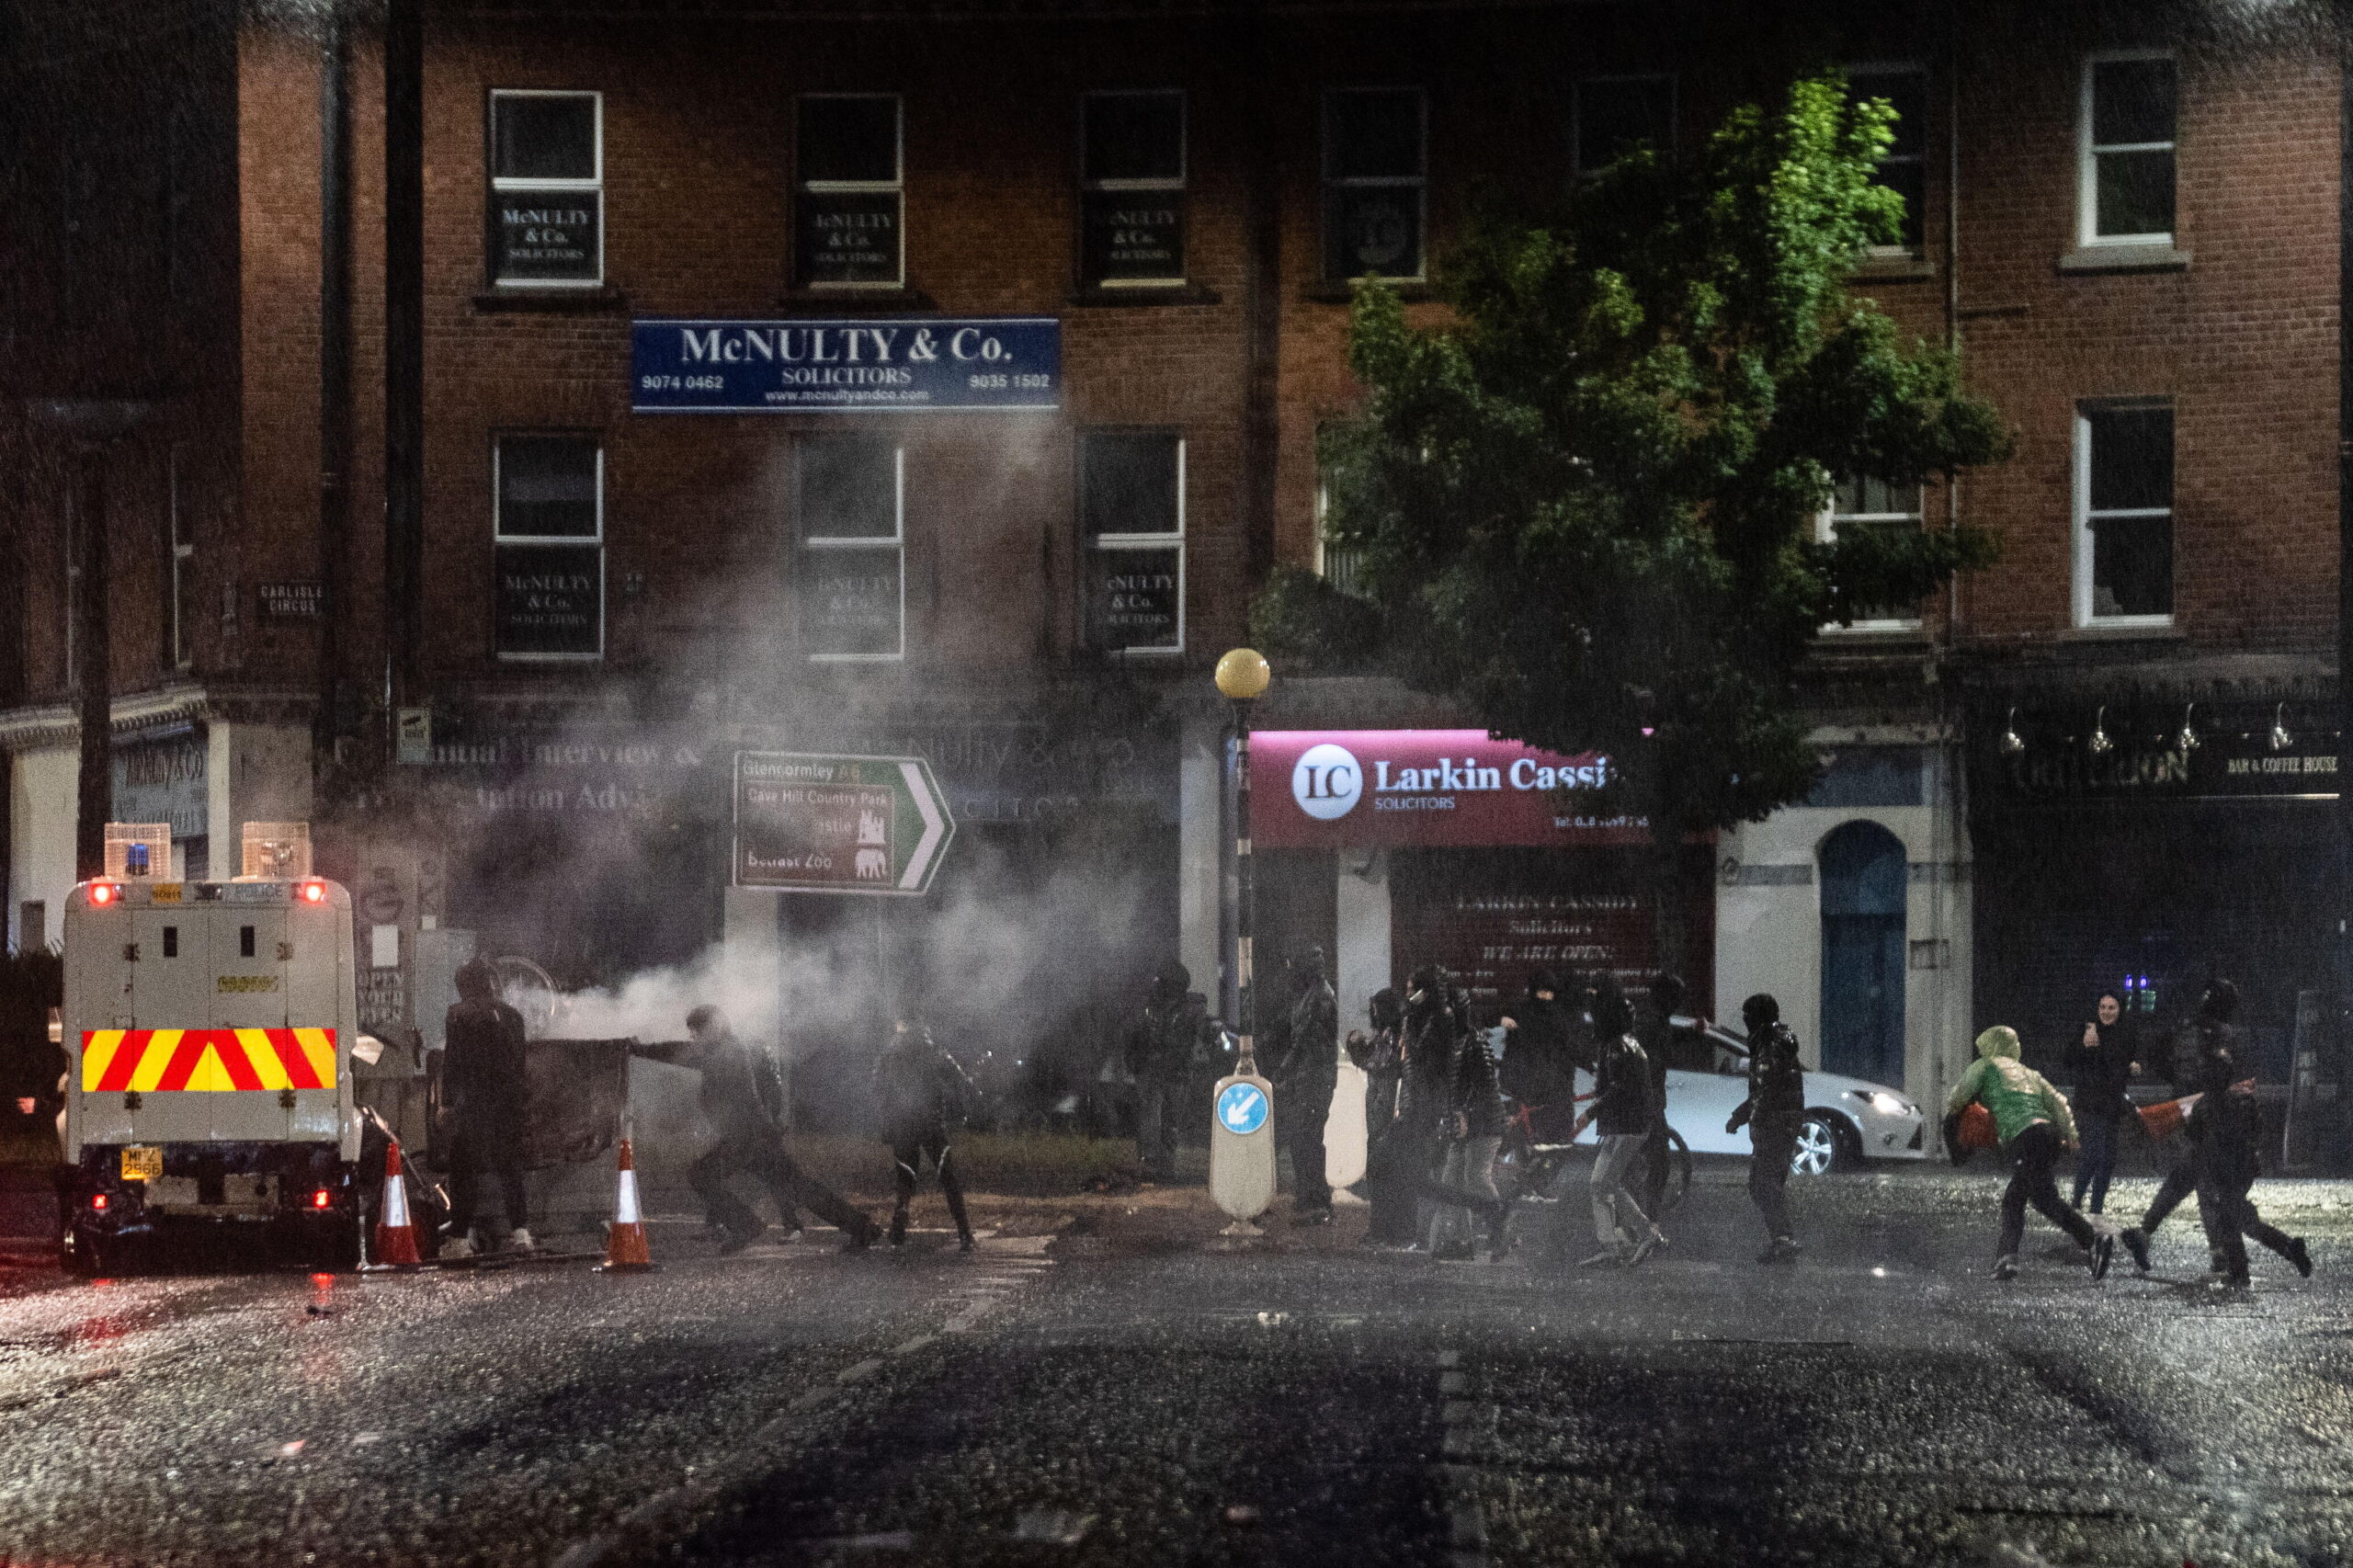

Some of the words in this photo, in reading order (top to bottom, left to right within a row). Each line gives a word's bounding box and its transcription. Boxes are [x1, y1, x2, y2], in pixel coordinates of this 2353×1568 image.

[502, 210, 589, 223] McNULTY
[526, 229, 539, 243] &
[679, 327, 899, 362] McNULTY
[907, 327, 938, 361] &
[950, 327, 1013, 361] Co.
[642, 375, 681, 390] 9074
[685, 375, 724, 390] 0462
[781, 368, 913, 385] SOLICITORS
[970, 373, 1008, 389] 9035
[1012, 373, 1051, 389] 1502
[765, 389, 930, 404] www.mcnultyandco.com
[505, 574, 591, 590] McNULTY
[260, 585, 323, 598] CARLISLE
[269, 598, 316, 613] CIRCUS
[2227, 759, 2250, 774] BAR
[2252, 760, 2259, 773] &
[2262, 757, 2301, 773] COFFEE
[2303, 756, 2339, 772] HOUSE
[1373, 757, 1502, 790] Larkin
[1508, 756, 1609, 790] Cassi
[782, 789, 804, 803] Hill
[808, 790, 857, 808] Country
[860, 792, 888, 806] Park
[1374, 795, 1456, 810] SOLICITORS
